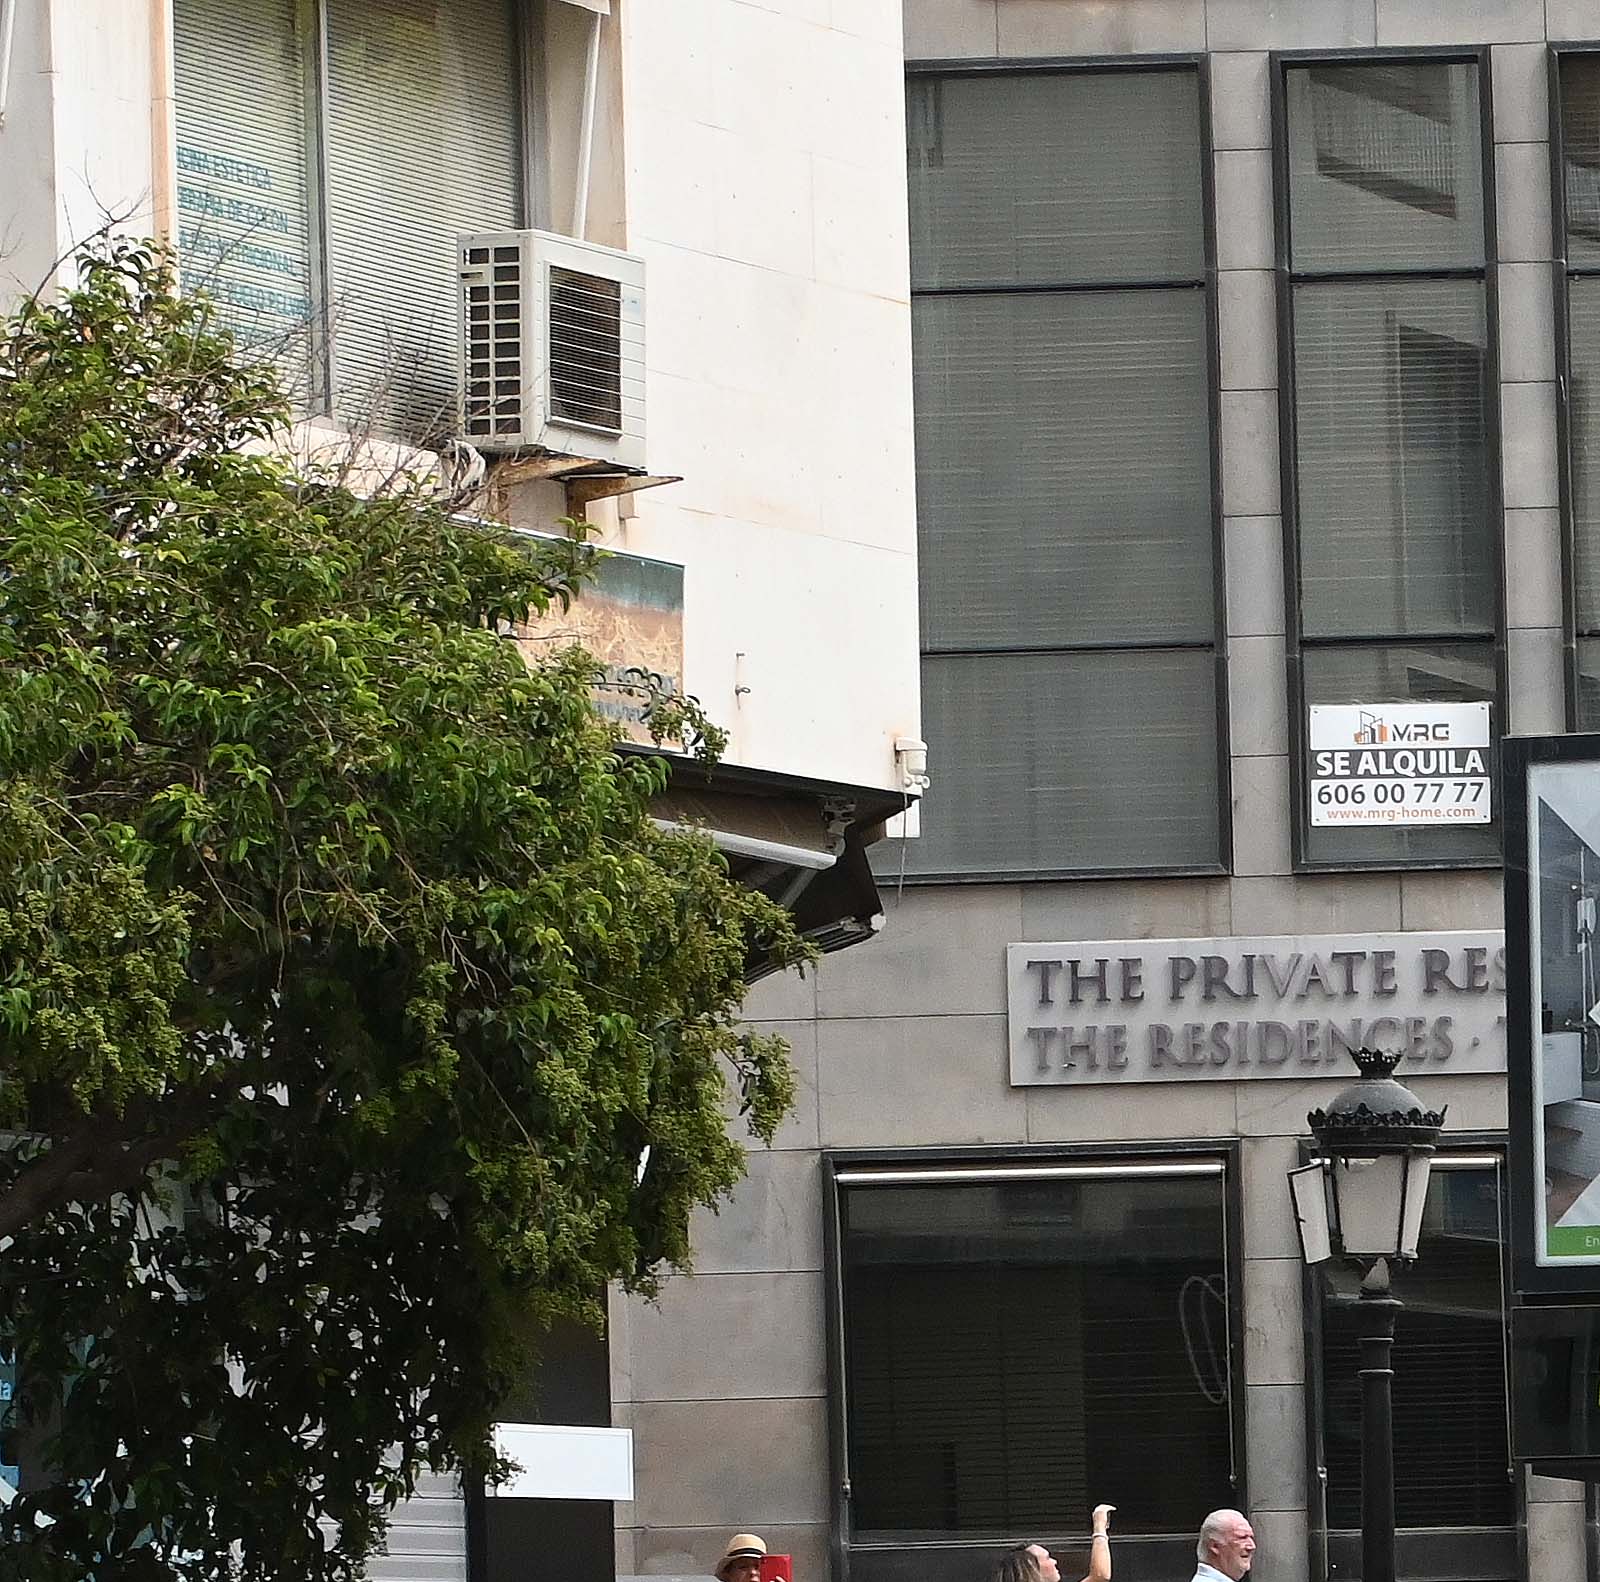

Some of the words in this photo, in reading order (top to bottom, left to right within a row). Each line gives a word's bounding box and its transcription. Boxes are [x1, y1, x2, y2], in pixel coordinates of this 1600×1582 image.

[1392, 723, 1449, 742] MRG
[1316, 752, 1350, 776] SE
[1357, 750, 1485, 777] ALQUILA
[1318, 784, 1365, 804] 606
[1374, 784, 1405, 803] 00
[1414, 783, 1444, 803] 77
[1453, 783, 1484, 802] 77
[1327, 807, 1476, 821] www.mrg-home.com
[1027, 958, 1144, 1002] THE
[1168, 951, 1398, 1000] PRIVATE
[1422, 947, 1506, 994] RES
[1027, 1025, 1128, 1070] THE
[1148, 1016, 1453, 1067] RESIDENCES
[1586, 1236, 1600, 1247] En
